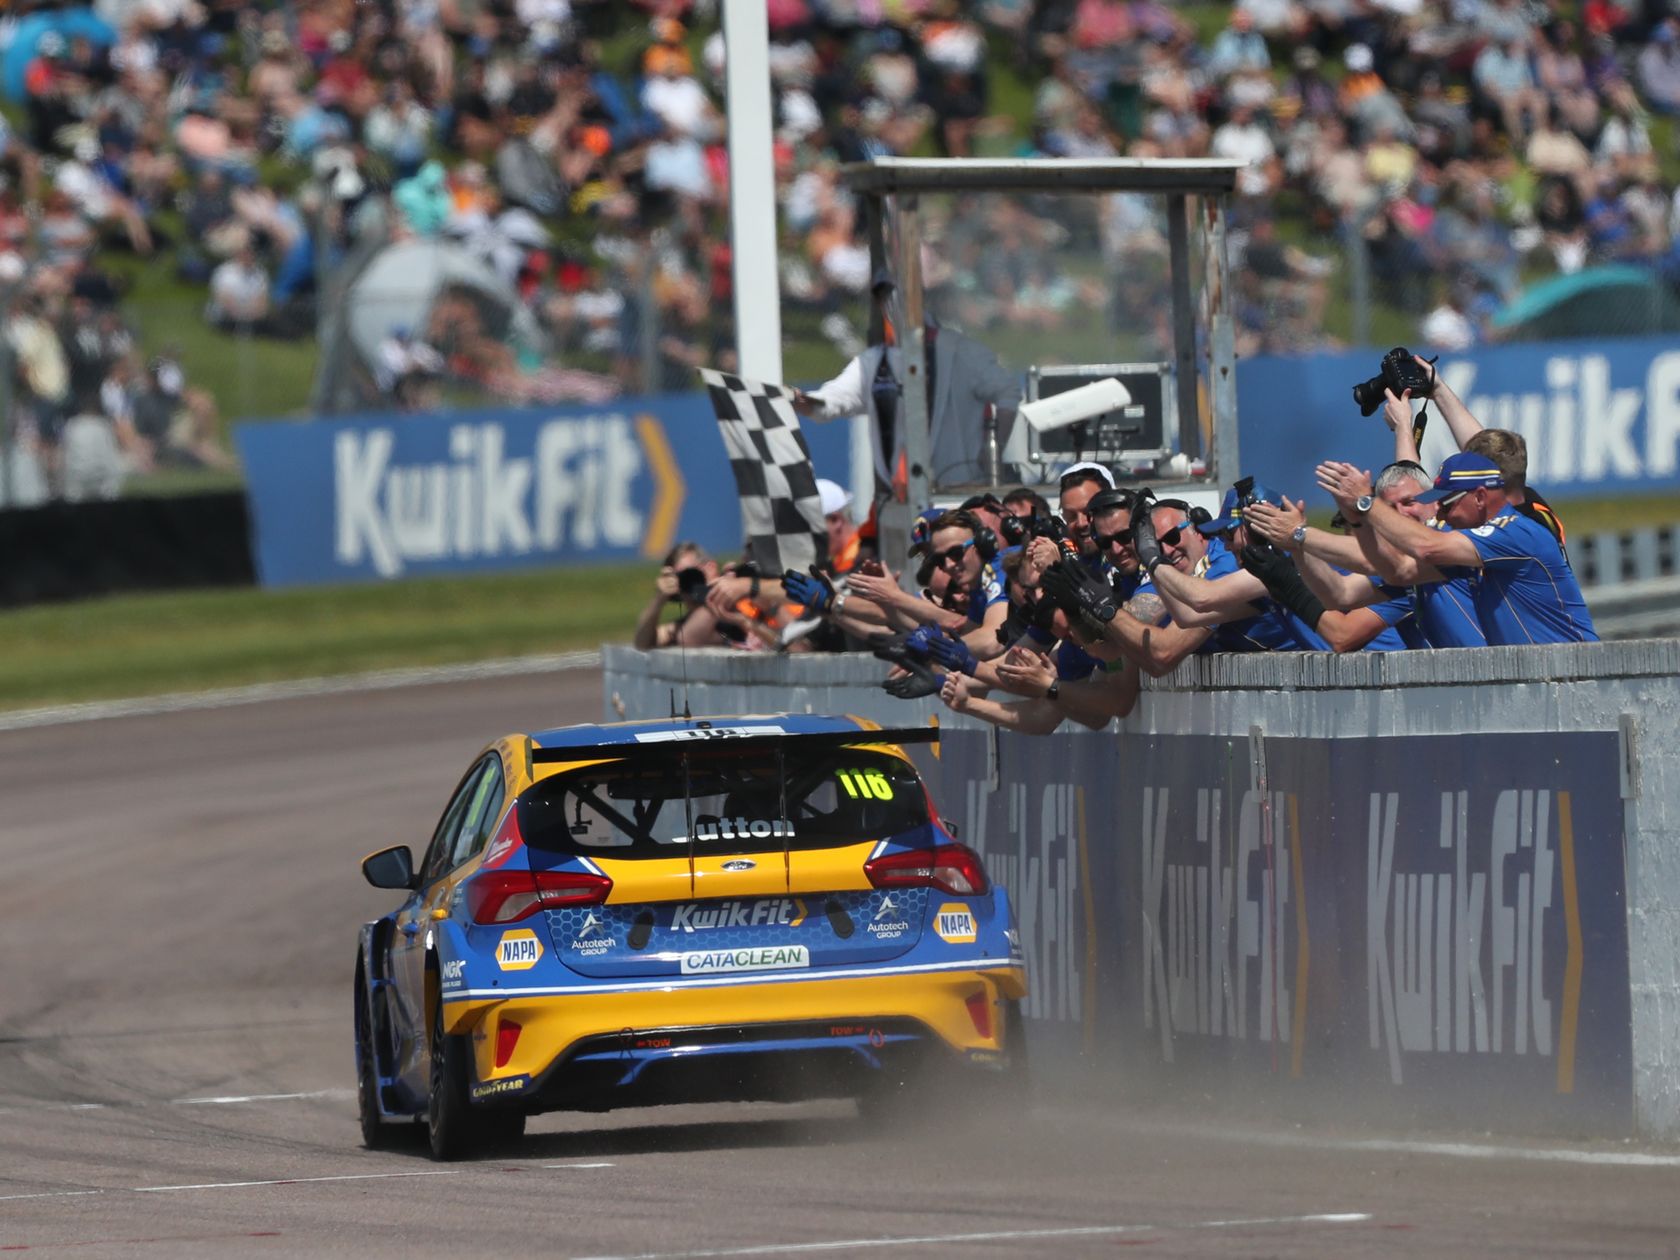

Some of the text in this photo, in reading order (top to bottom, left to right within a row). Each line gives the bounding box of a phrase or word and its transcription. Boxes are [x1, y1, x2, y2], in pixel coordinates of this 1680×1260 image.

[835, 767, 893, 800] 116
[671, 816, 796, 842] utton
[867, 921, 909, 932] Autotech
[876, 931, 902, 939] GROUP
[940, 914, 973, 935] NAPA
[503, 941, 536, 962] NAPA
[571, 937, 616, 949] Autotech
[580, 947, 608, 957] GROUP
[687, 947, 802, 969] CATACLEAN
